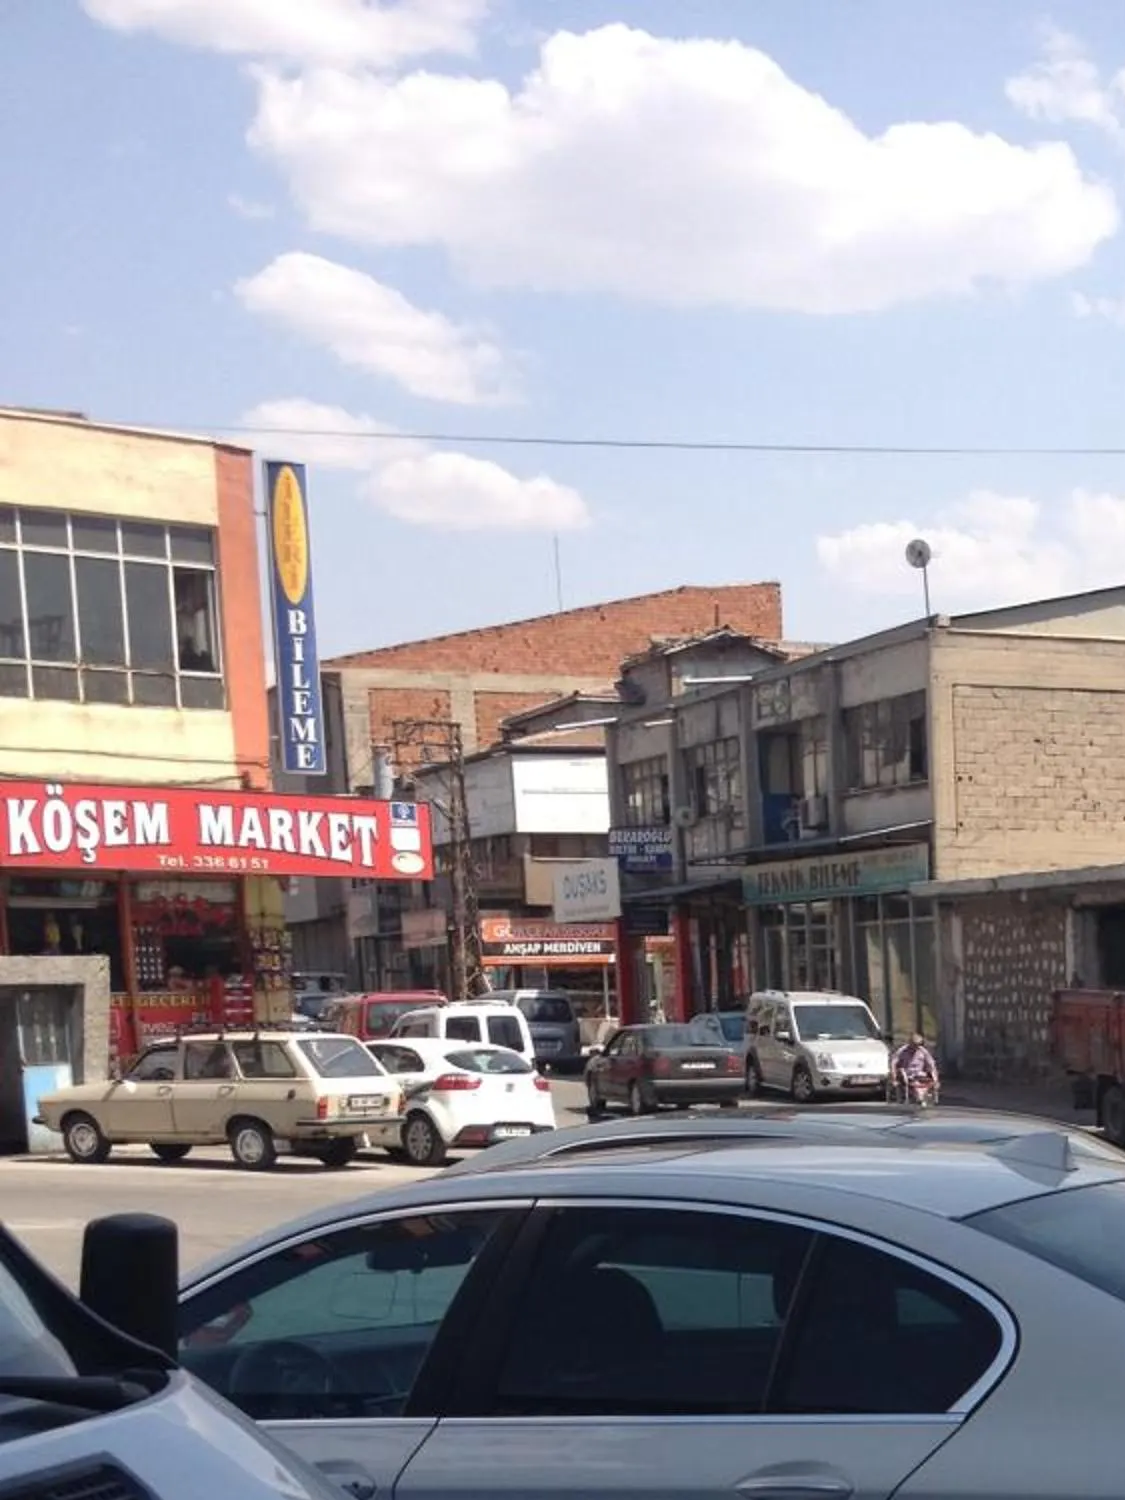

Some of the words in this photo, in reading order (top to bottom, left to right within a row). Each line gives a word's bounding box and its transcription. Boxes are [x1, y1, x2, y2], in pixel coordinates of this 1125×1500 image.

[287, 609, 319, 769] BİLEME
[6, 783, 171, 863] KÖŞEM
[199, 803, 378, 868] MARKET
[159, 855, 189, 868] Tel.
